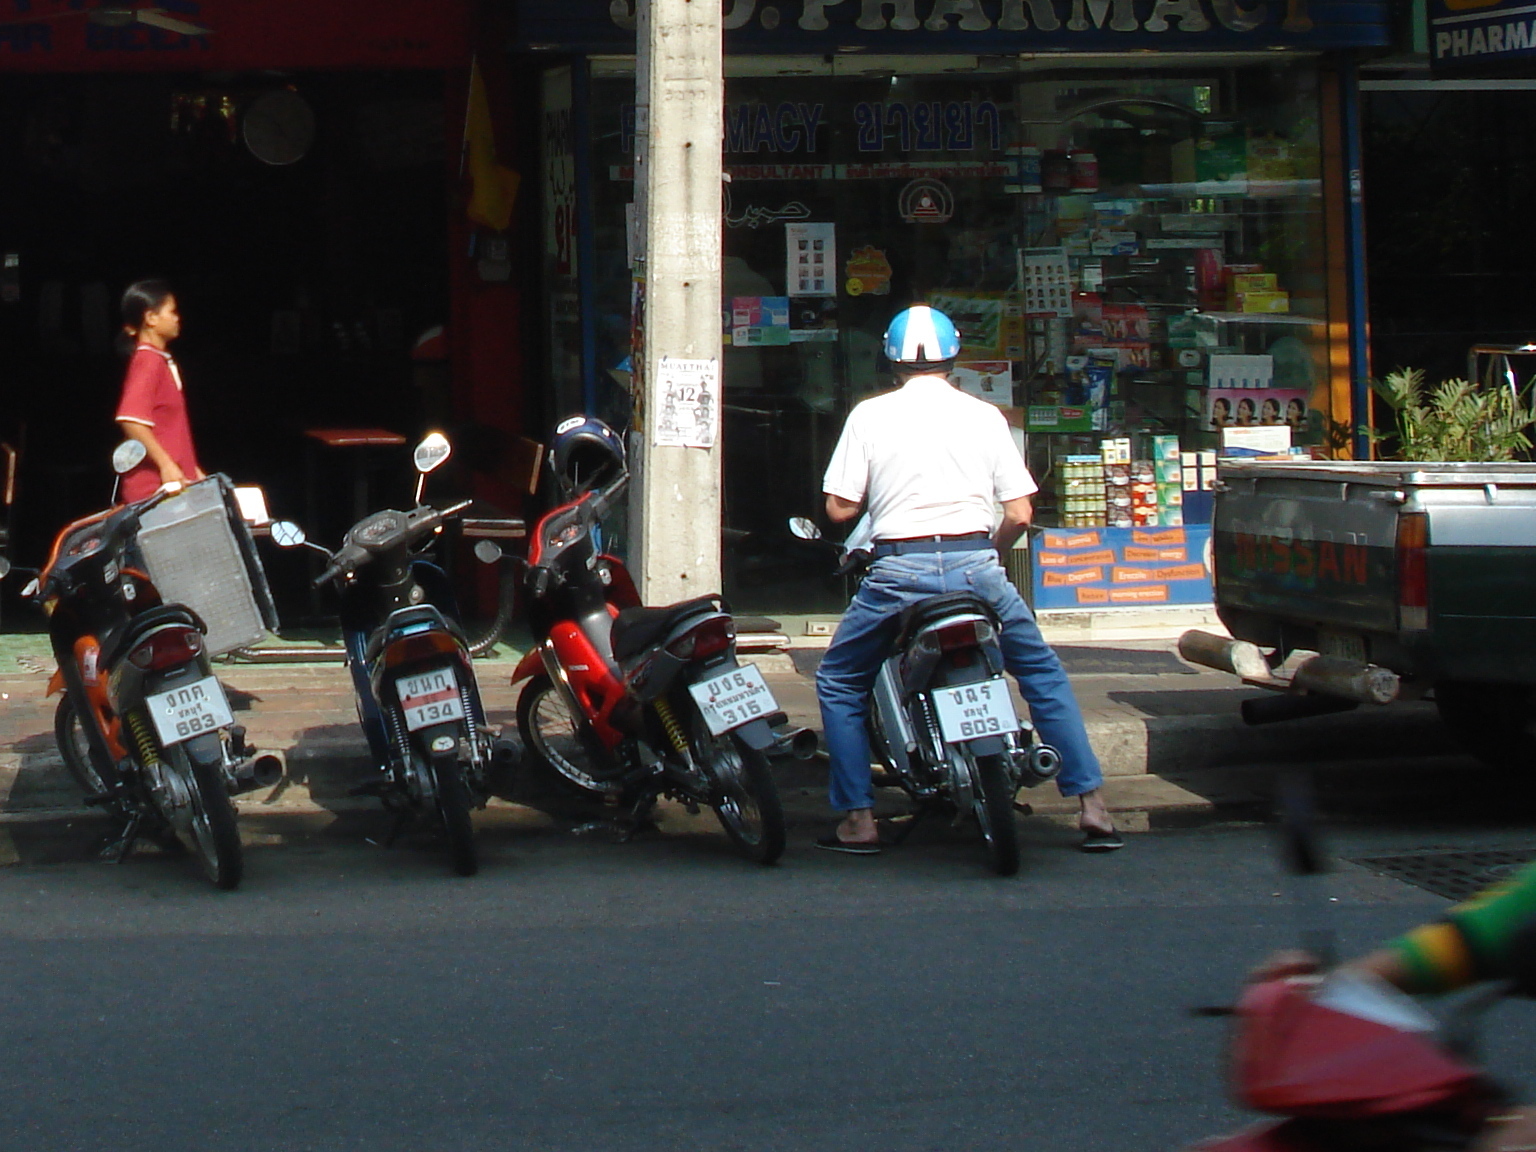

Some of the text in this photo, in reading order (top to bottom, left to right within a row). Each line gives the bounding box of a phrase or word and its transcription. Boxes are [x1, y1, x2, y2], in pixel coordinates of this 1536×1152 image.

[621, 103, 823, 153] PMACY
[854, 101, 1001, 152] ขายยา
[679, 388, 695, 402] 12
[1234, 520, 1369, 583] NISSAN
[177, 702, 203, 719] ชลบุรี
[417, 703, 454, 722] 134
[963, 703, 989, 718] ชลบุรี
[175, 713, 216, 737] 683
[960, 717, 1001, 737] 603
